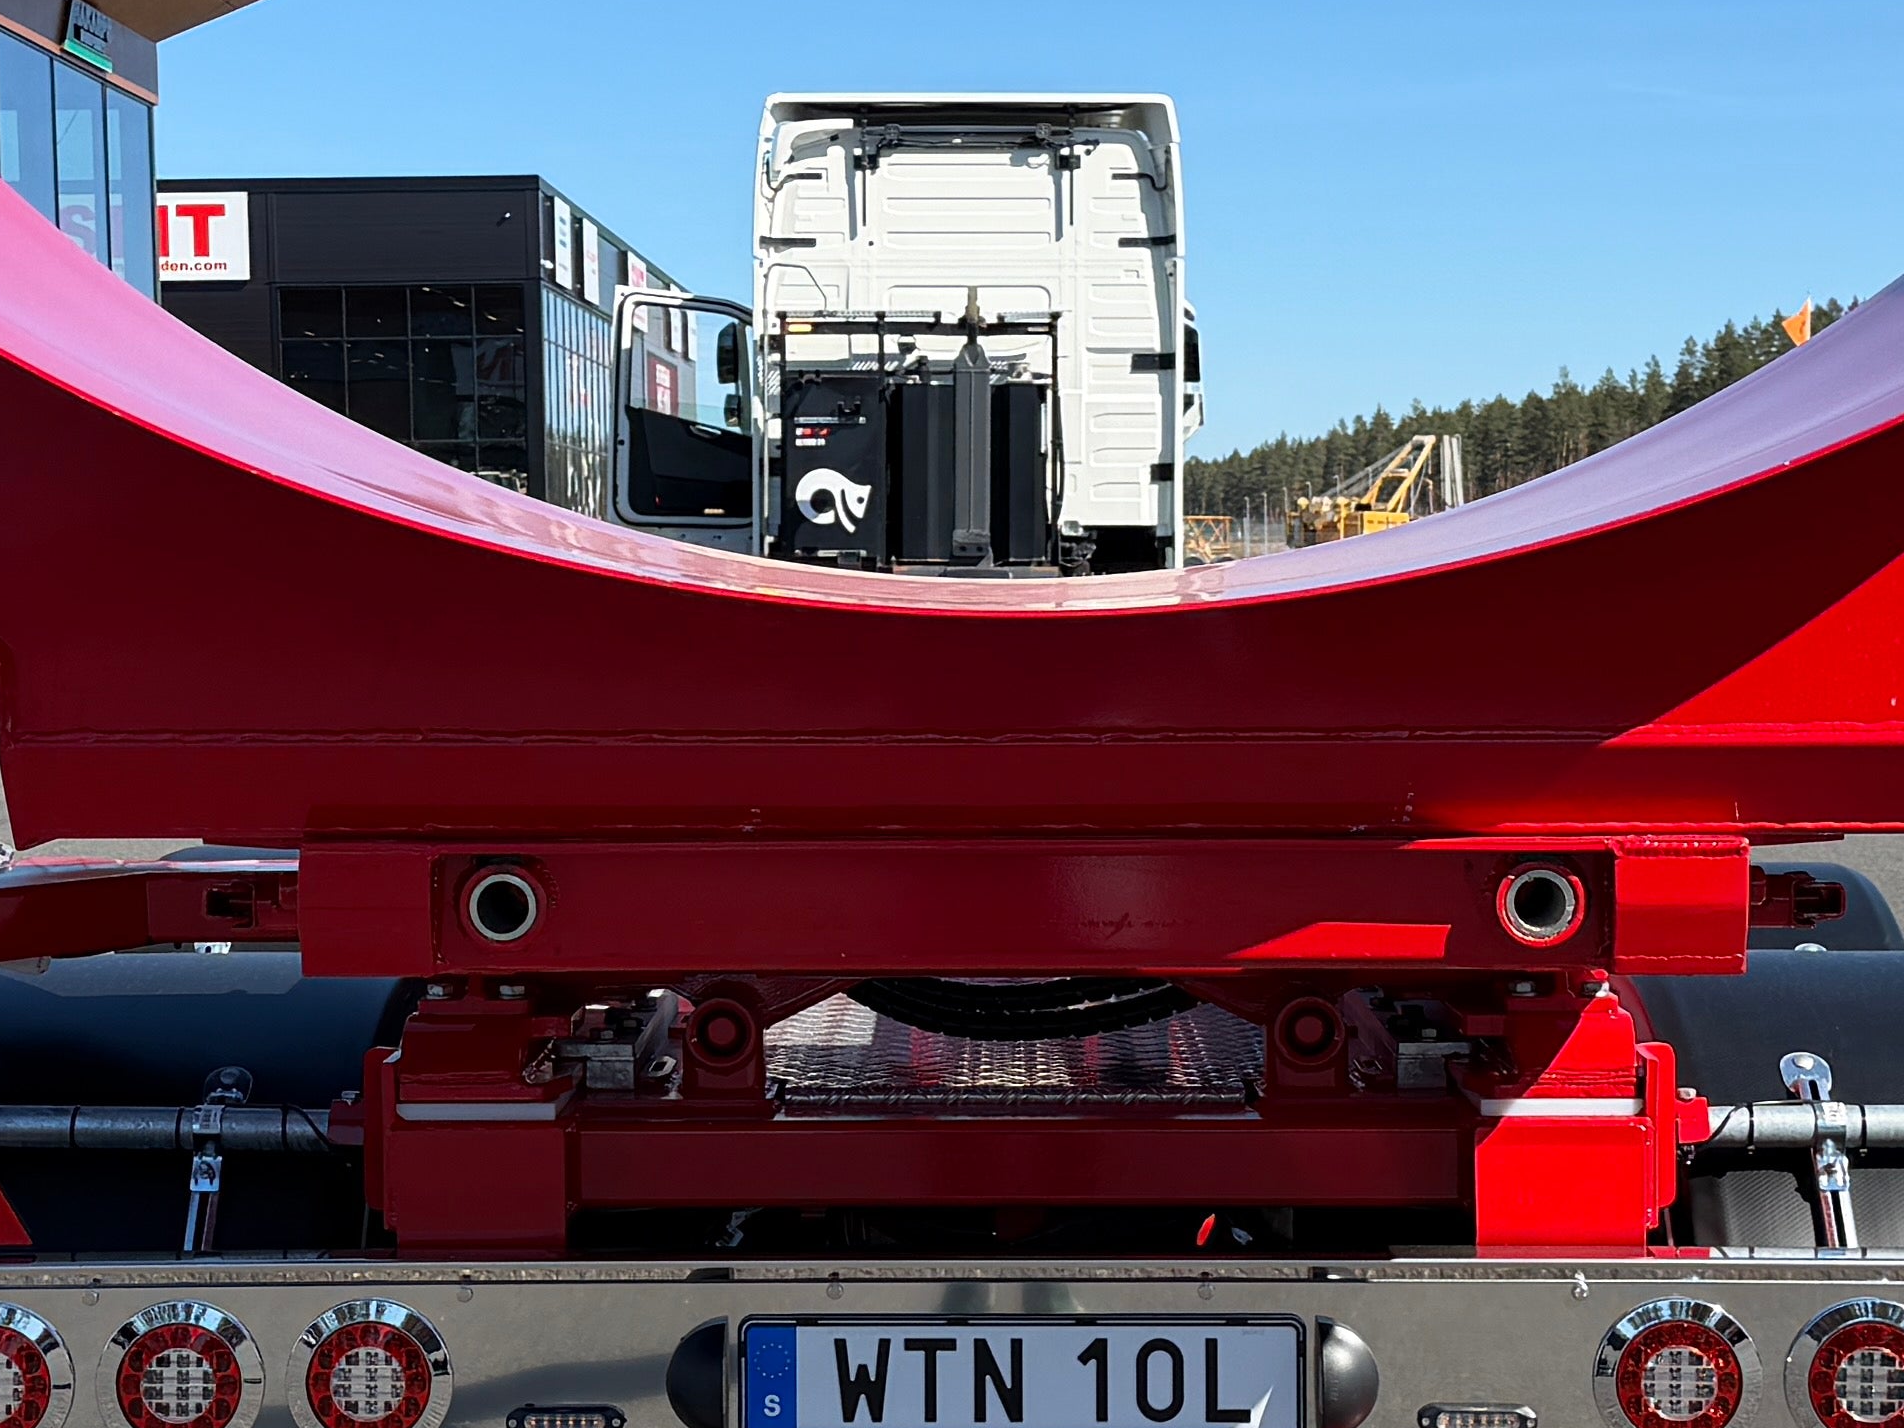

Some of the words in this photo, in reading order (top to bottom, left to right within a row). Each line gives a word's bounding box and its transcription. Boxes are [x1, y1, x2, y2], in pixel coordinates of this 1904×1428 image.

[763, 1394, 781, 1417] S
[833, 1338, 1024, 1423] WTN
[1077, 1338, 1251, 1423] 10L
